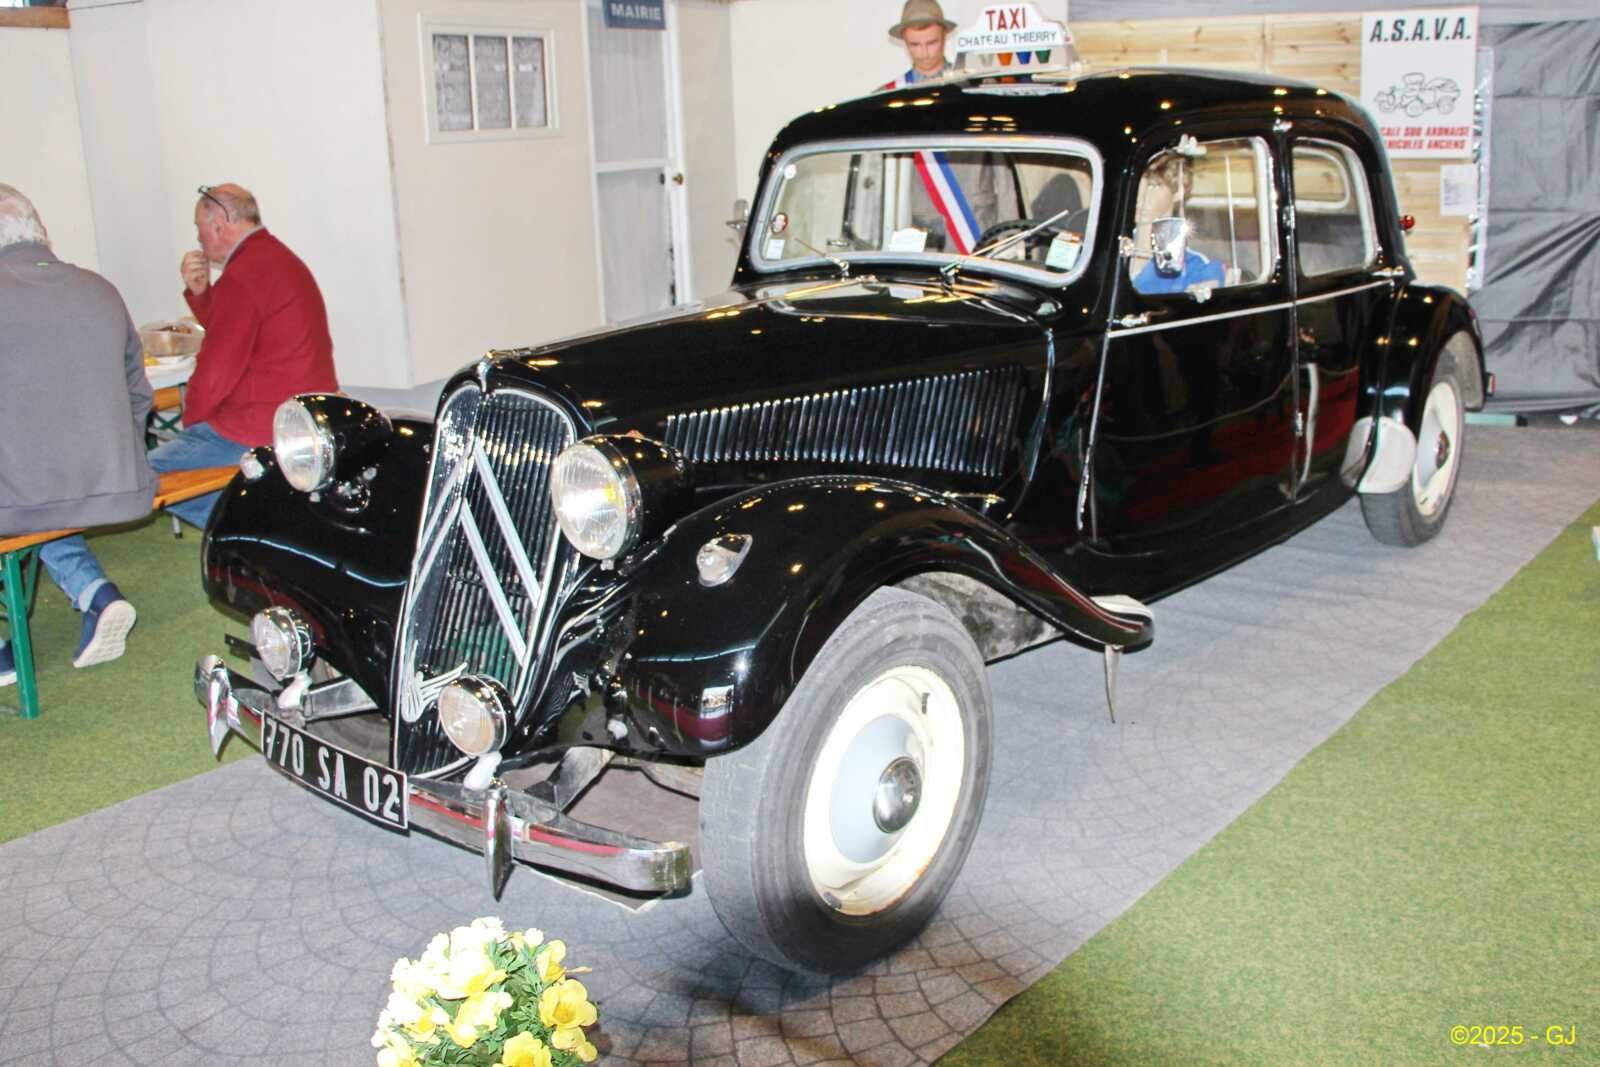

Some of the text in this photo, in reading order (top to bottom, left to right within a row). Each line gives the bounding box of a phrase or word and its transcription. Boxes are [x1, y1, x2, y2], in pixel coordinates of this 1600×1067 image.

[609, 3, 662, 19] MAIRIE
[985, 8, 1027, 31] TAXI
[958, 31, 1057, 48] CHATEAU THIERRY
[1369, 16, 1472, 43] A.S.A.V.A.
[265, 718, 401, 823] 770 SA 02
